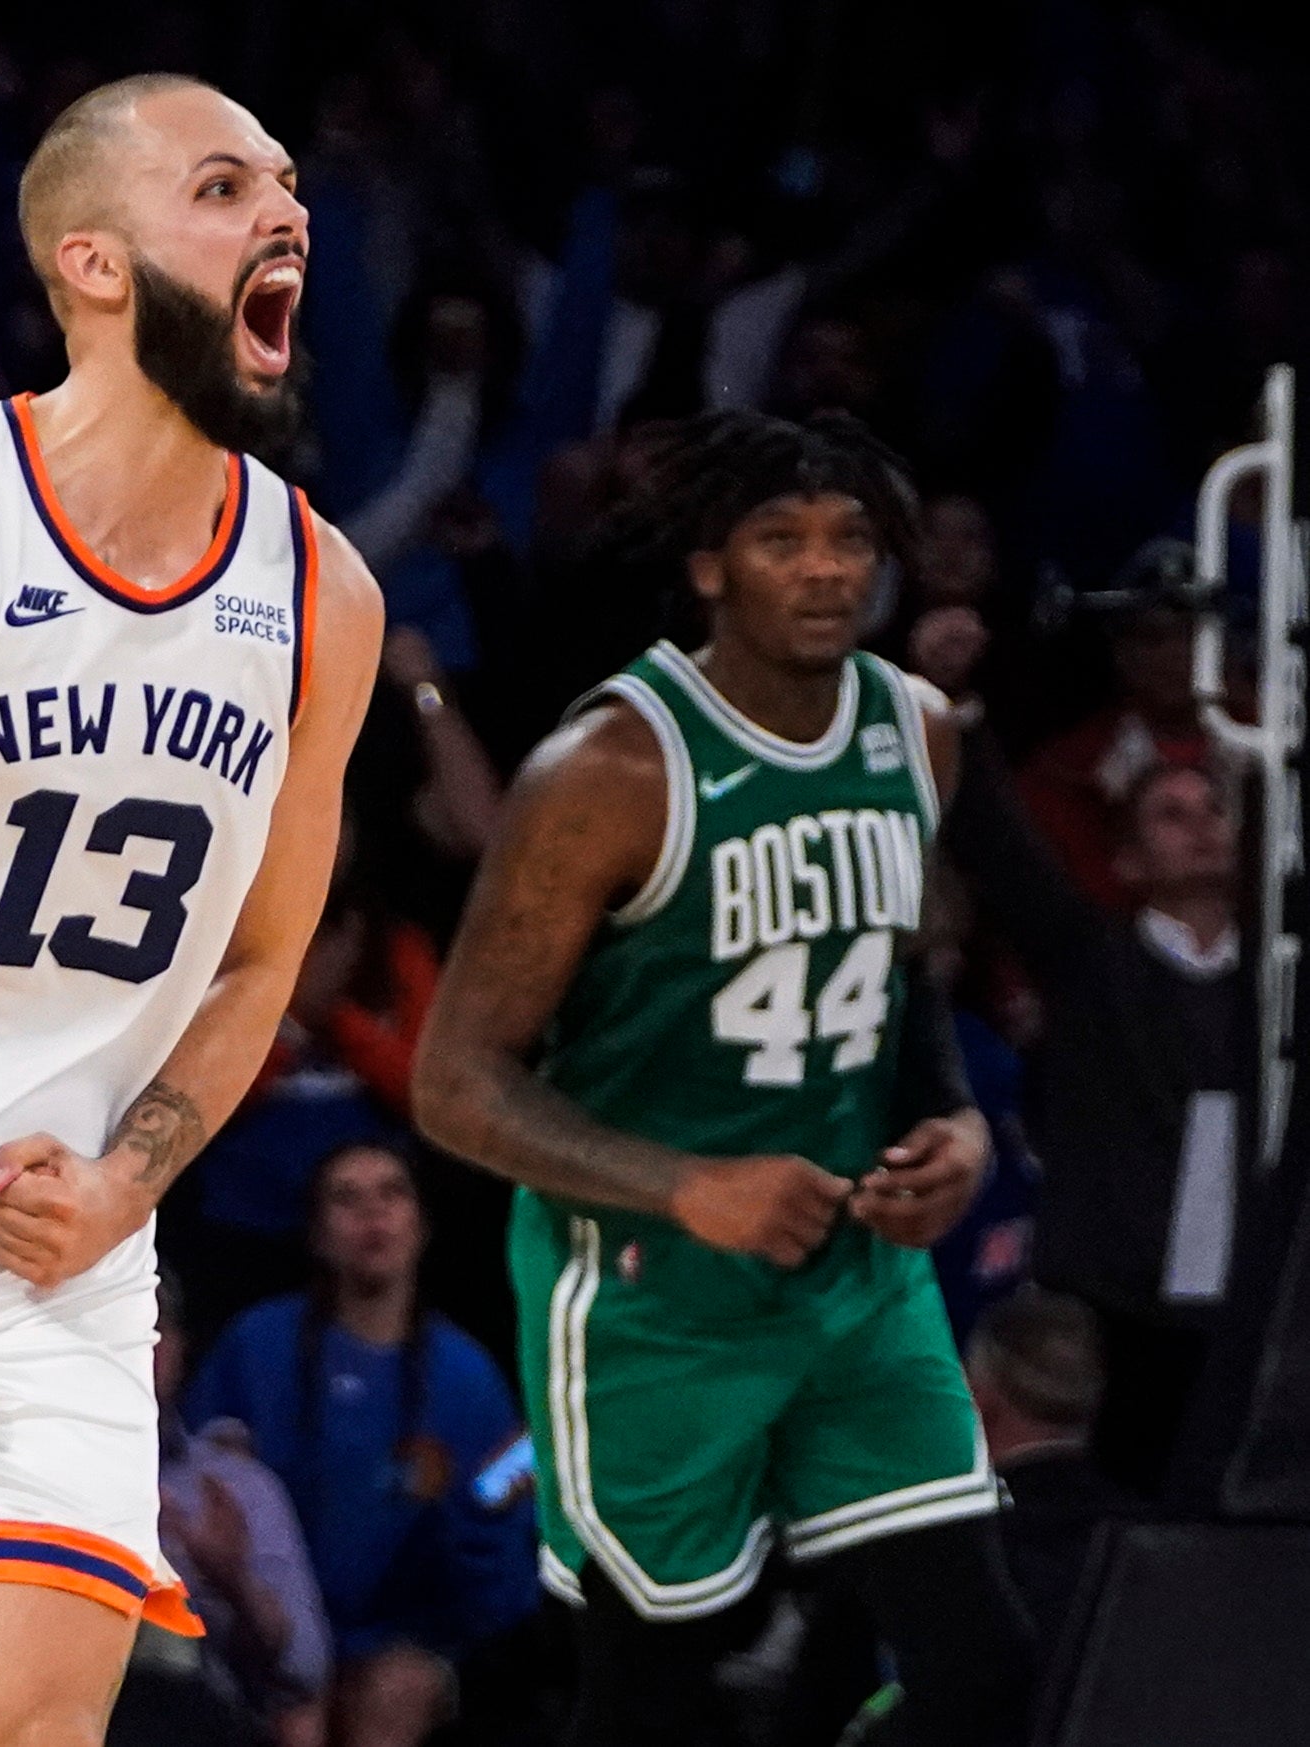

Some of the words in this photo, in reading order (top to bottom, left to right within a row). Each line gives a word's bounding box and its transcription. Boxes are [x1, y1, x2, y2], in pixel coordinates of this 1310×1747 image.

[15, 584, 69, 614] NIKE
[214, 615, 275, 642] SPACE
[215, 594, 287, 624] SQUARE
[142, 683, 274, 797] YORK
[711, 809, 923, 961] BOSTON
[711, 931, 892, 1087] 44
